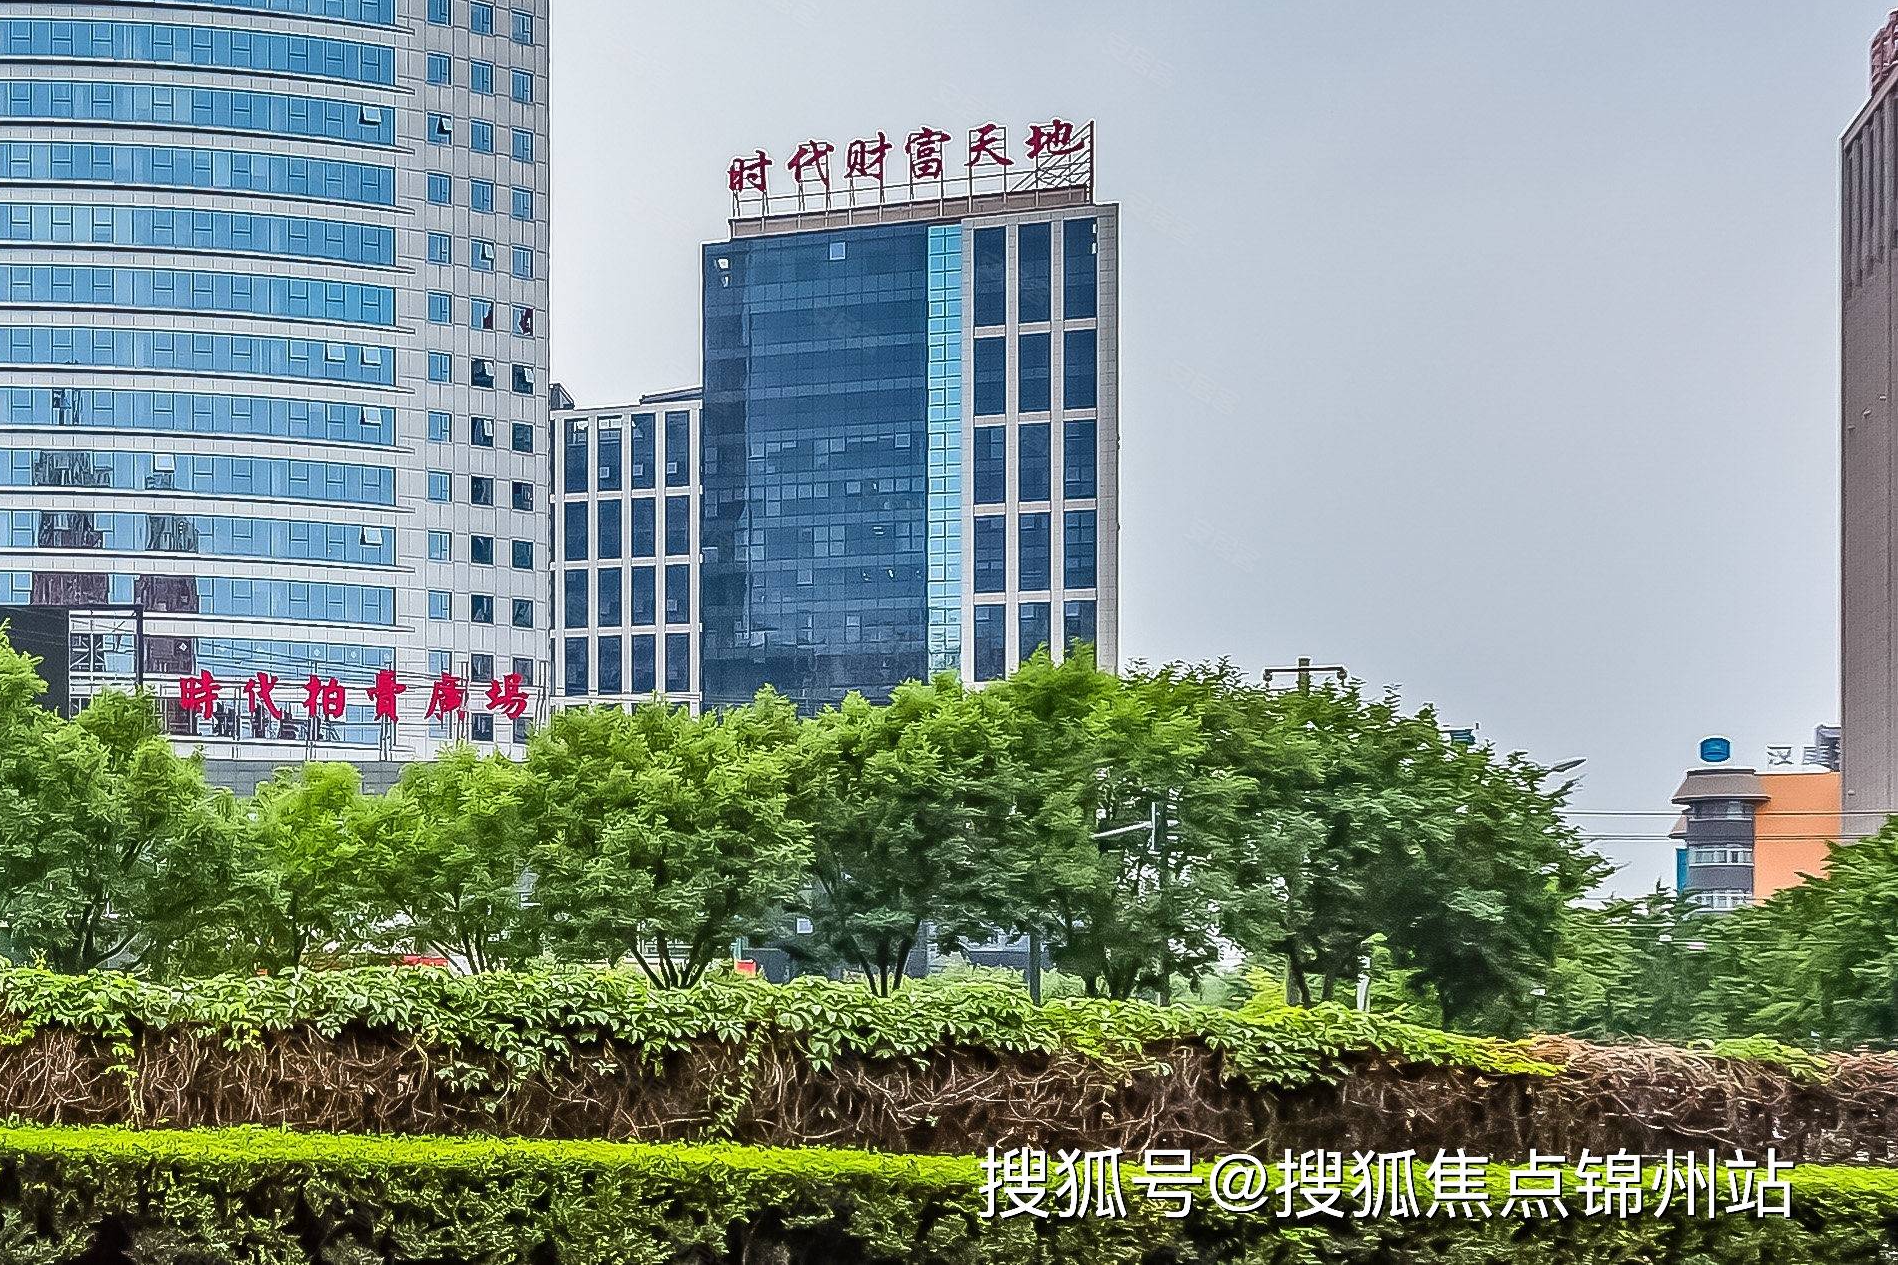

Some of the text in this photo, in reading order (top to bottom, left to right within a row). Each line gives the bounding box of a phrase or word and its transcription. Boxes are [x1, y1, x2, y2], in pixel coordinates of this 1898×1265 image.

[727, 119, 1085, 191] 时代财富天地
